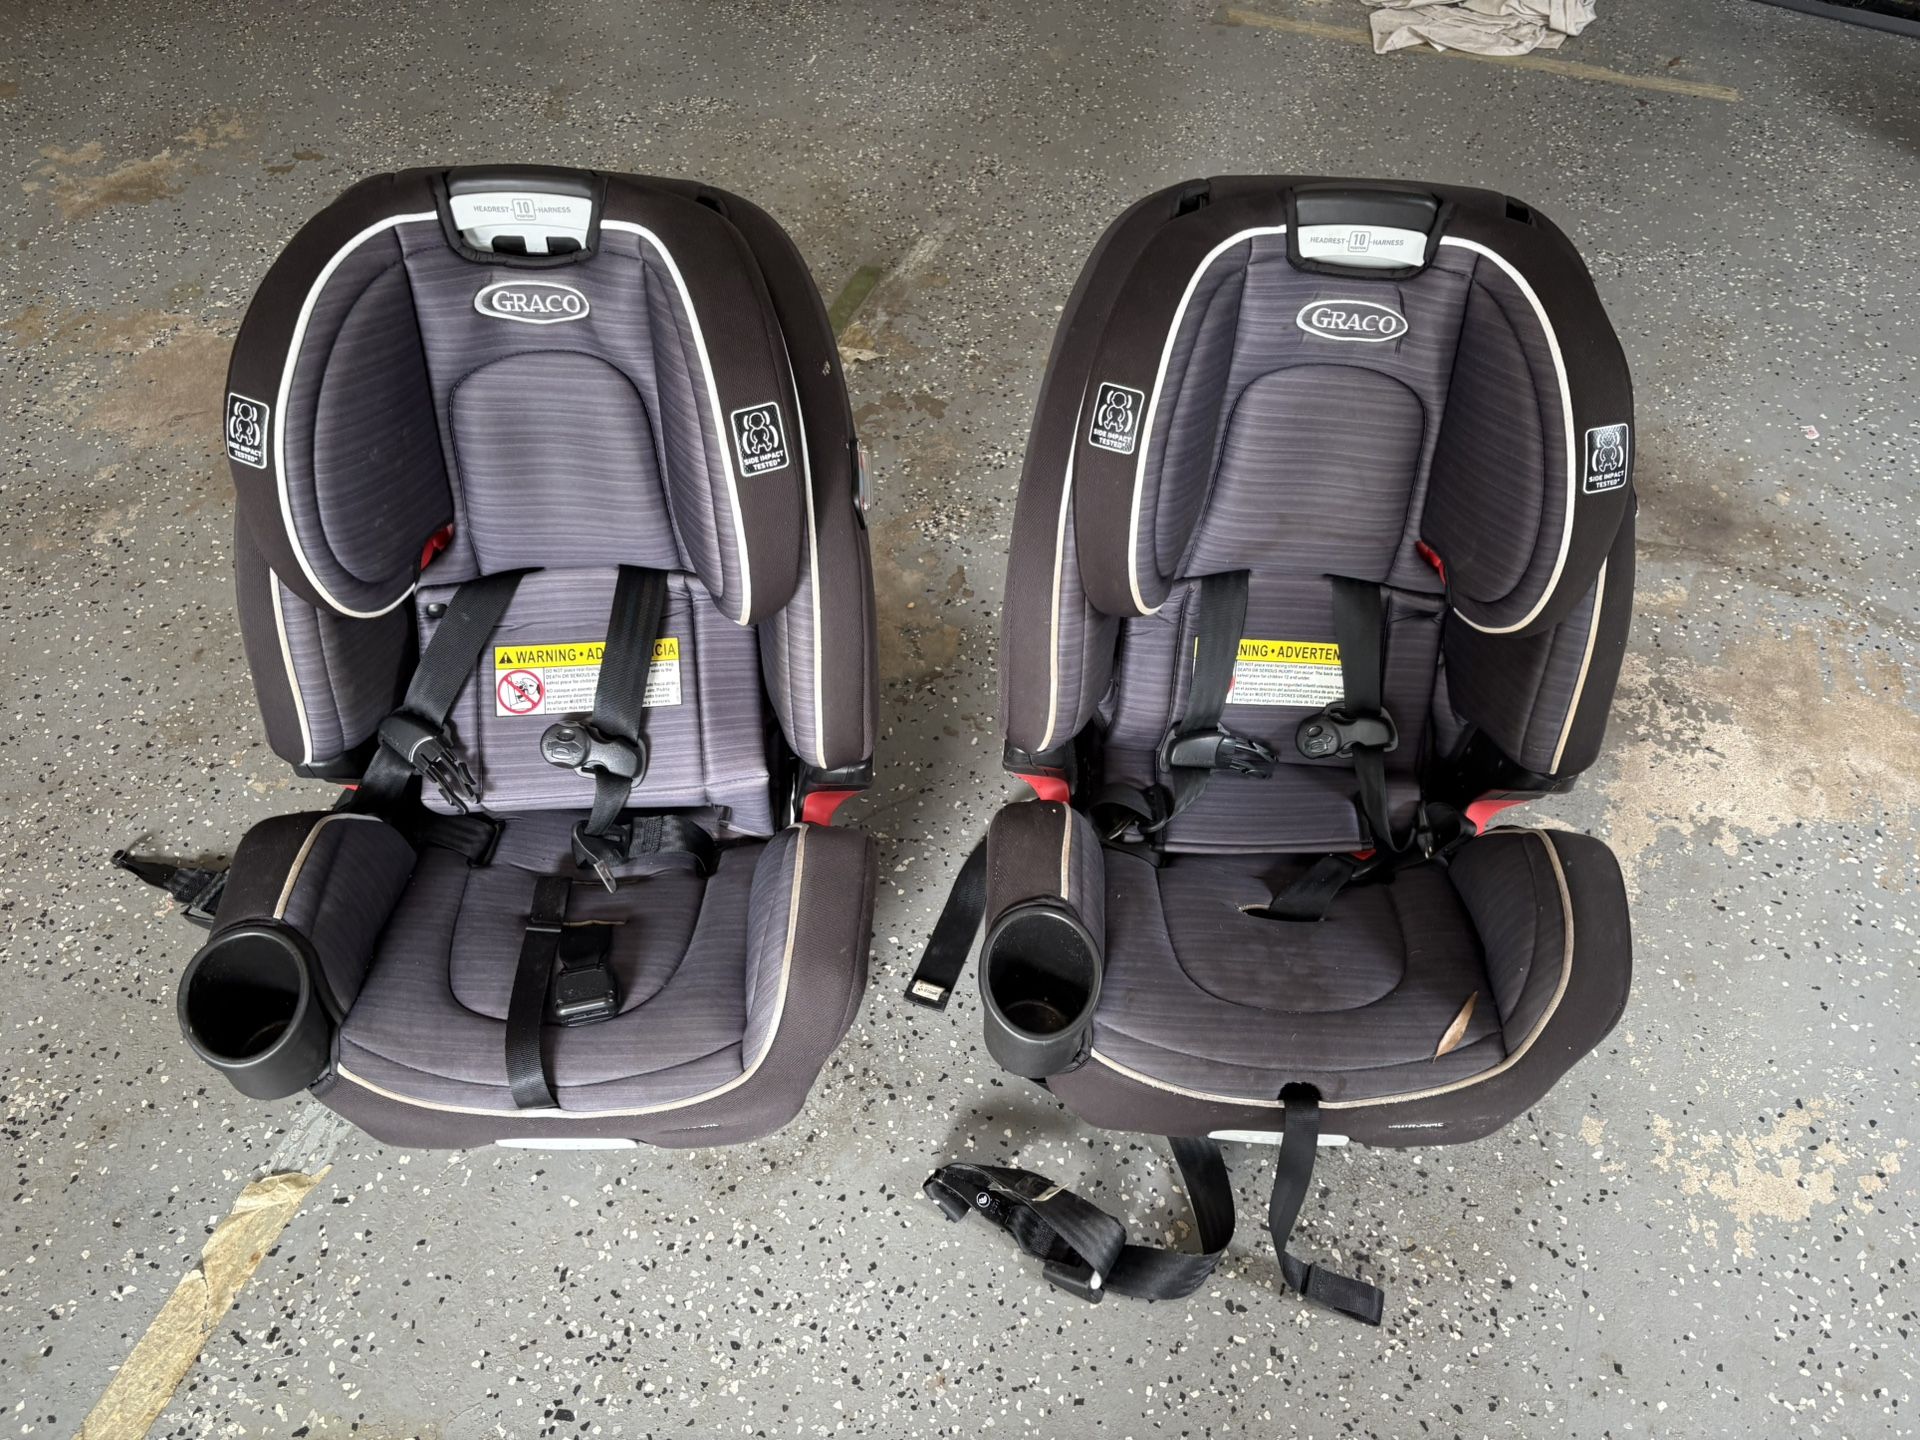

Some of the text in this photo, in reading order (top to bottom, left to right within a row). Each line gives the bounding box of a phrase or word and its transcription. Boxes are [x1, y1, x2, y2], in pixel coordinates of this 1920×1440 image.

[474, 205, 509, 214] HEADREST
[516, 201, 530, 214] 10
[1354, 234, 1366, 246] 10
[492, 290, 580, 313] GRACO
[1312, 307, 1397, 334] GRACO
[1094, 428, 1132, 444] SIDE IMPACT
[229, 440, 262, 457] SIDE IMPACT
[744, 450, 784, 466] SIDE IMPACT
[1604, 470, 1624, 480] IMPACT
[516, 649, 576, 663] WARNING
[1240, 644, 1340, 660] NING ADVERTEN
